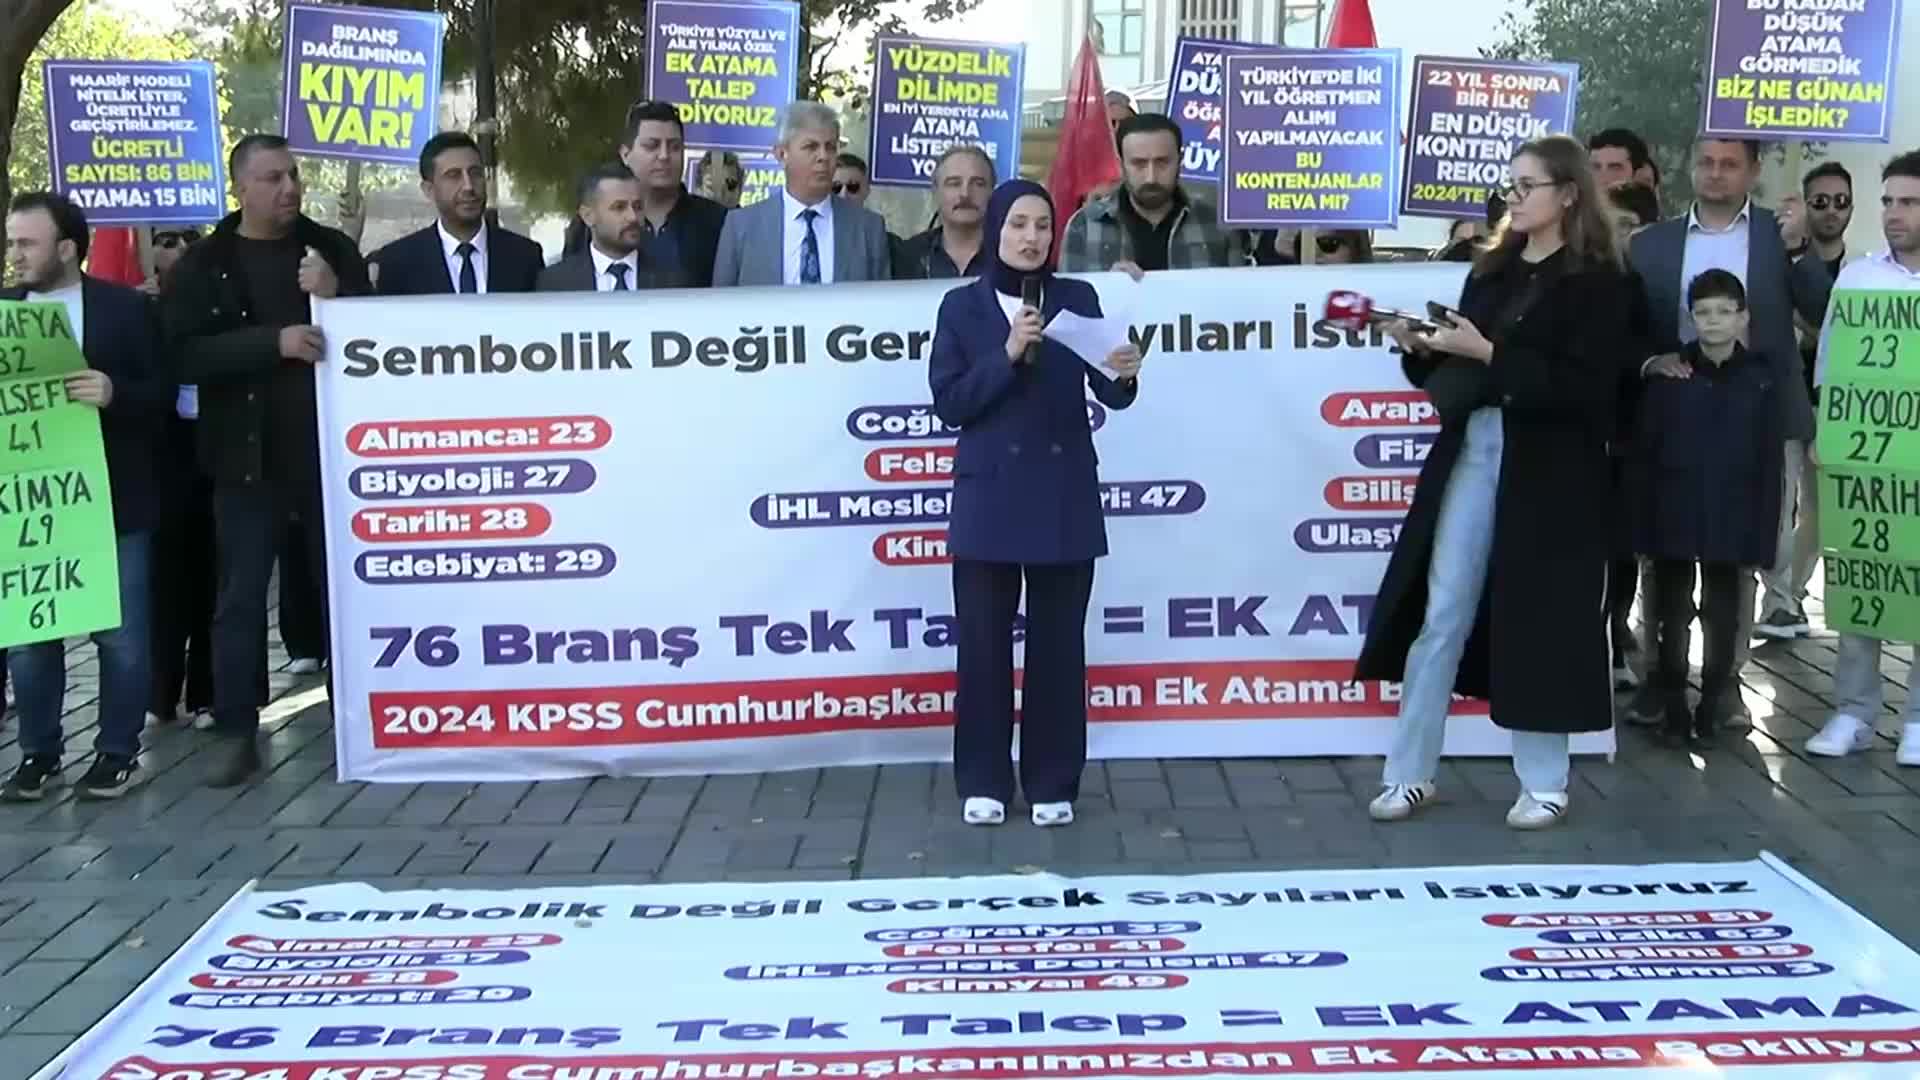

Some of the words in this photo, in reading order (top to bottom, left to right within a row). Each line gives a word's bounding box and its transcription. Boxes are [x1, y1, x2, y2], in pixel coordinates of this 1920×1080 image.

[332, 24, 398, 45] BRANŞ
[660, 24, 714, 38] TÜRKİYE
[768, 29, 786, 41] VE
[1764, 11, 1845, 34] DÜŞÜK
[302, 39, 426, 66] DAĞILIMINDA
[668, 37, 697, 50] AİLE
[744, 40, 776, 53] ÖZEL
[1760, 35, 1843, 53] ATAMA
[666, 52, 695, 72] EK
[700, 54, 777, 77] ATAMA
[889, 45, 1011, 77] YÜZDELİK
[1740, 52, 1862, 75] GÖRMEDİK
[70, 73, 131, 87] MAARİF
[133, 74, 191, 87] MODELİ
[300, 64, 425, 110] KIYIM
[687, 78, 755, 100] TALEP
[1240, 66, 1353, 86] TÜRKİYE'DE
[1357, 65, 1381, 85] İKİ
[1427, 71, 1453, 87] 22
[1456, 72, 1487, 89] YIL
[1490, 74, 1560, 93] SONRA
[1717, 74, 1753, 98] BİZ
[1759, 80, 1791, 99] NE
[1796, 76, 1884, 102] GÜNAH
[77, 88, 136, 102] NİTELİK
[898, 78, 998, 106] DİLİMDE
[1240, 90, 1270, 106] YIL
[1274, 86, 1381, 106] ÖĞRETMEN
[1455, 87, 1488, 107] BİR
[1491, 88, 1529, 110] İLK:
[86, 102, 180, 117] ÜCRETLİYLE
[672, 100, 776, 127] DİYORUZ
[884, 104, 900, 115] EN
[901, 102, 917, 116] İYİ
[919, 104, 980, 118] YERDEYİZ
[981, 108, 1009, 120] AMA
[1283, 110, 1336, 126] ALIMI
[1745, 102, 1848, 129] İŞLEDİK?
[307, 104, 414, 148] VAR!
[911, 119, 979, 137] ATAMA
[1236, 130, 1384, 147] YAPILMAYACAK
[1430, 112, 1463, 134] EN
[1467, 111, 1551, 140] DÜŞÜK
[92, 135, 184, 158] ÜCRETLİ
[65, 163, 142, 183] SAYISI:
[146, 163, 172, 182] 86
[176, 160, 213, 182] BİN
[1296, 153, 1321, 169] BU
[1236, 172, 1383, 190] KONTENJANLAR
[1412, 183, 1486, 203] 2024'TE
[68, 187, 150, 208] ATAMA:
[154, 187, 176, 206] 15
[180, 183, 217, 206] BİN
[1267, 193, 1315, 211] REVA
[1320, 194, 1349, 211] MI?
[0, 306, 71, 339] AFYA
[343, 331, 634, 378] Sembolik
[651, 325, 806, 372] Değil
[1857, 334, 1899, 369] 23
[9, 420, 43, 453] 41
[359, 422, 540, 451] Almanca:
[548, 422, 597, 446] 23
[1847, 431, 1893, 465] 27
[360, 466, 514, 496] Biyoloji:
[523, 465, 571, 488] 27
[767, 493, 831, 521] İHL
[1140, 486, 1188, 508] 47
[1828, 473, 1920, 516] TARİH
[18, 513, 55, 548] 49
[362, 511, 471, 535] Tarih:
[480, 509, 528, 532] 28
[1851, 517, 1889, 552] 28
[1, 556, 84, 598] FİZİK
[365, 550, 546, 583] Edebiyat:
[555, 549, 603, 574] 29
[1824, 556, 1920, 597] EDEBİYAT
[29, 599, 57, 630] 61
[1850, 595, 1885, 628] 29
[369, 625, 460, 668] 76
[482, 621, 699, 667] Branş
[720, 610, 856, 657] Tek
[1167, 595, 1271, 638] EK
[383, 704, 495, 735] 2024
[507, 702, 623, 733] KPSS
[1156, 679, 1207, 706] Ek
[1221, 677, 1366, 705] Atama
[257, 899, 608, 924] Sembolik
[630, 898, 823, 919] Değil
[848, 888, 1105, 912] Gerçek
[1127, 885, 1403, 907] Sayıları
[1424, 879, 1758, 902] İstiyoruz
[1257, 952, 1324, 966] 47
[305, 1023, 623, 1050] Branş
[657, 1017, 850, 1041] Tek
[881, 1011, 1188, 1038] Talep
[1315, 1003, 1473, 1027] EK
[1500, 994, 1918, 1025] ATAMA
[299, 1063, 488, 1080] KPSS
[507, 1050, 1293, 1080] Cumhurbaşkanımızdan
[1311, 1044, 1393, 1066] Ek
[1415, 1043, 1642, 1065] Atama
[1653, 1037, 1920, 1058] Bekliyo
